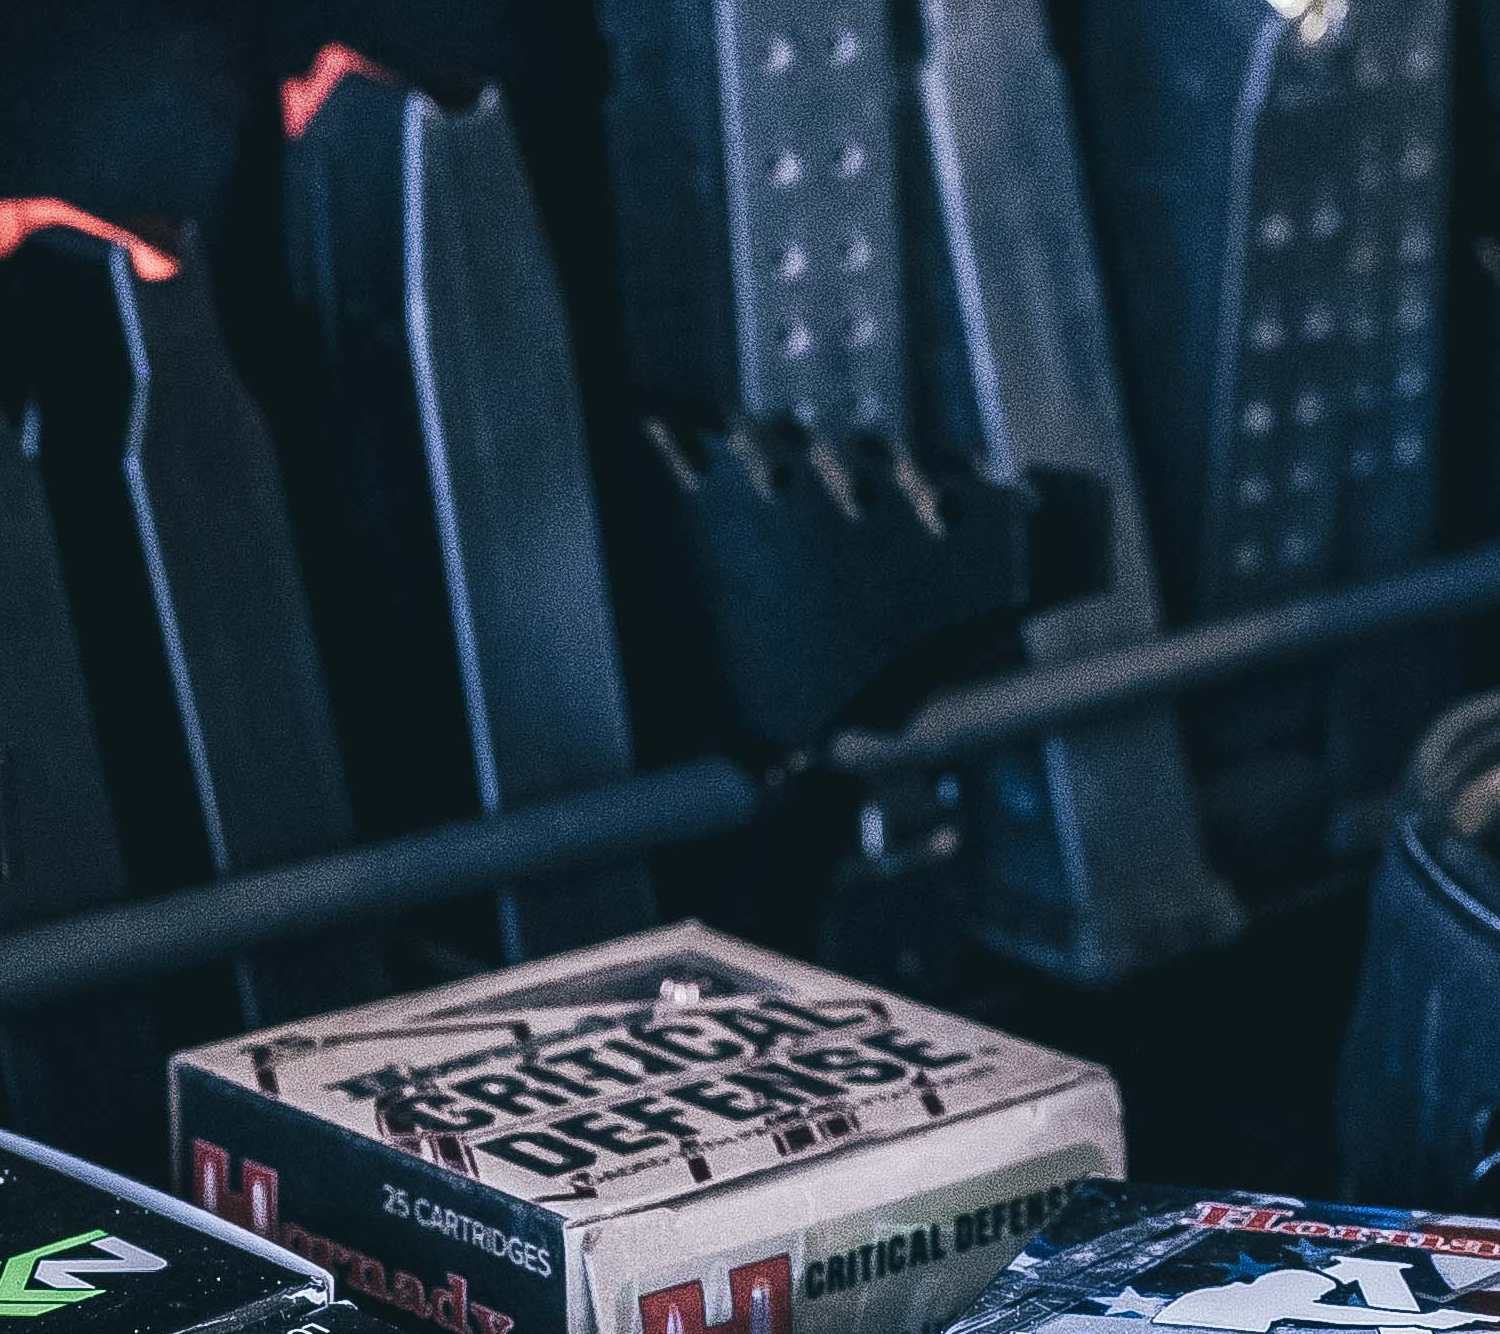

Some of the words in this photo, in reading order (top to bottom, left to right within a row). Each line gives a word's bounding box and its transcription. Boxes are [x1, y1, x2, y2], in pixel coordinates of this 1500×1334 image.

[408, 996, 870, 1131] CRITICAL
[478, 1035, 969, 1177] DEFENSE
[380, 1183, 410, 1219] 25
[413, 1197, 553, 1278] CARTRIDGES
[805, 1222, 946, 1299] CRITICAL
